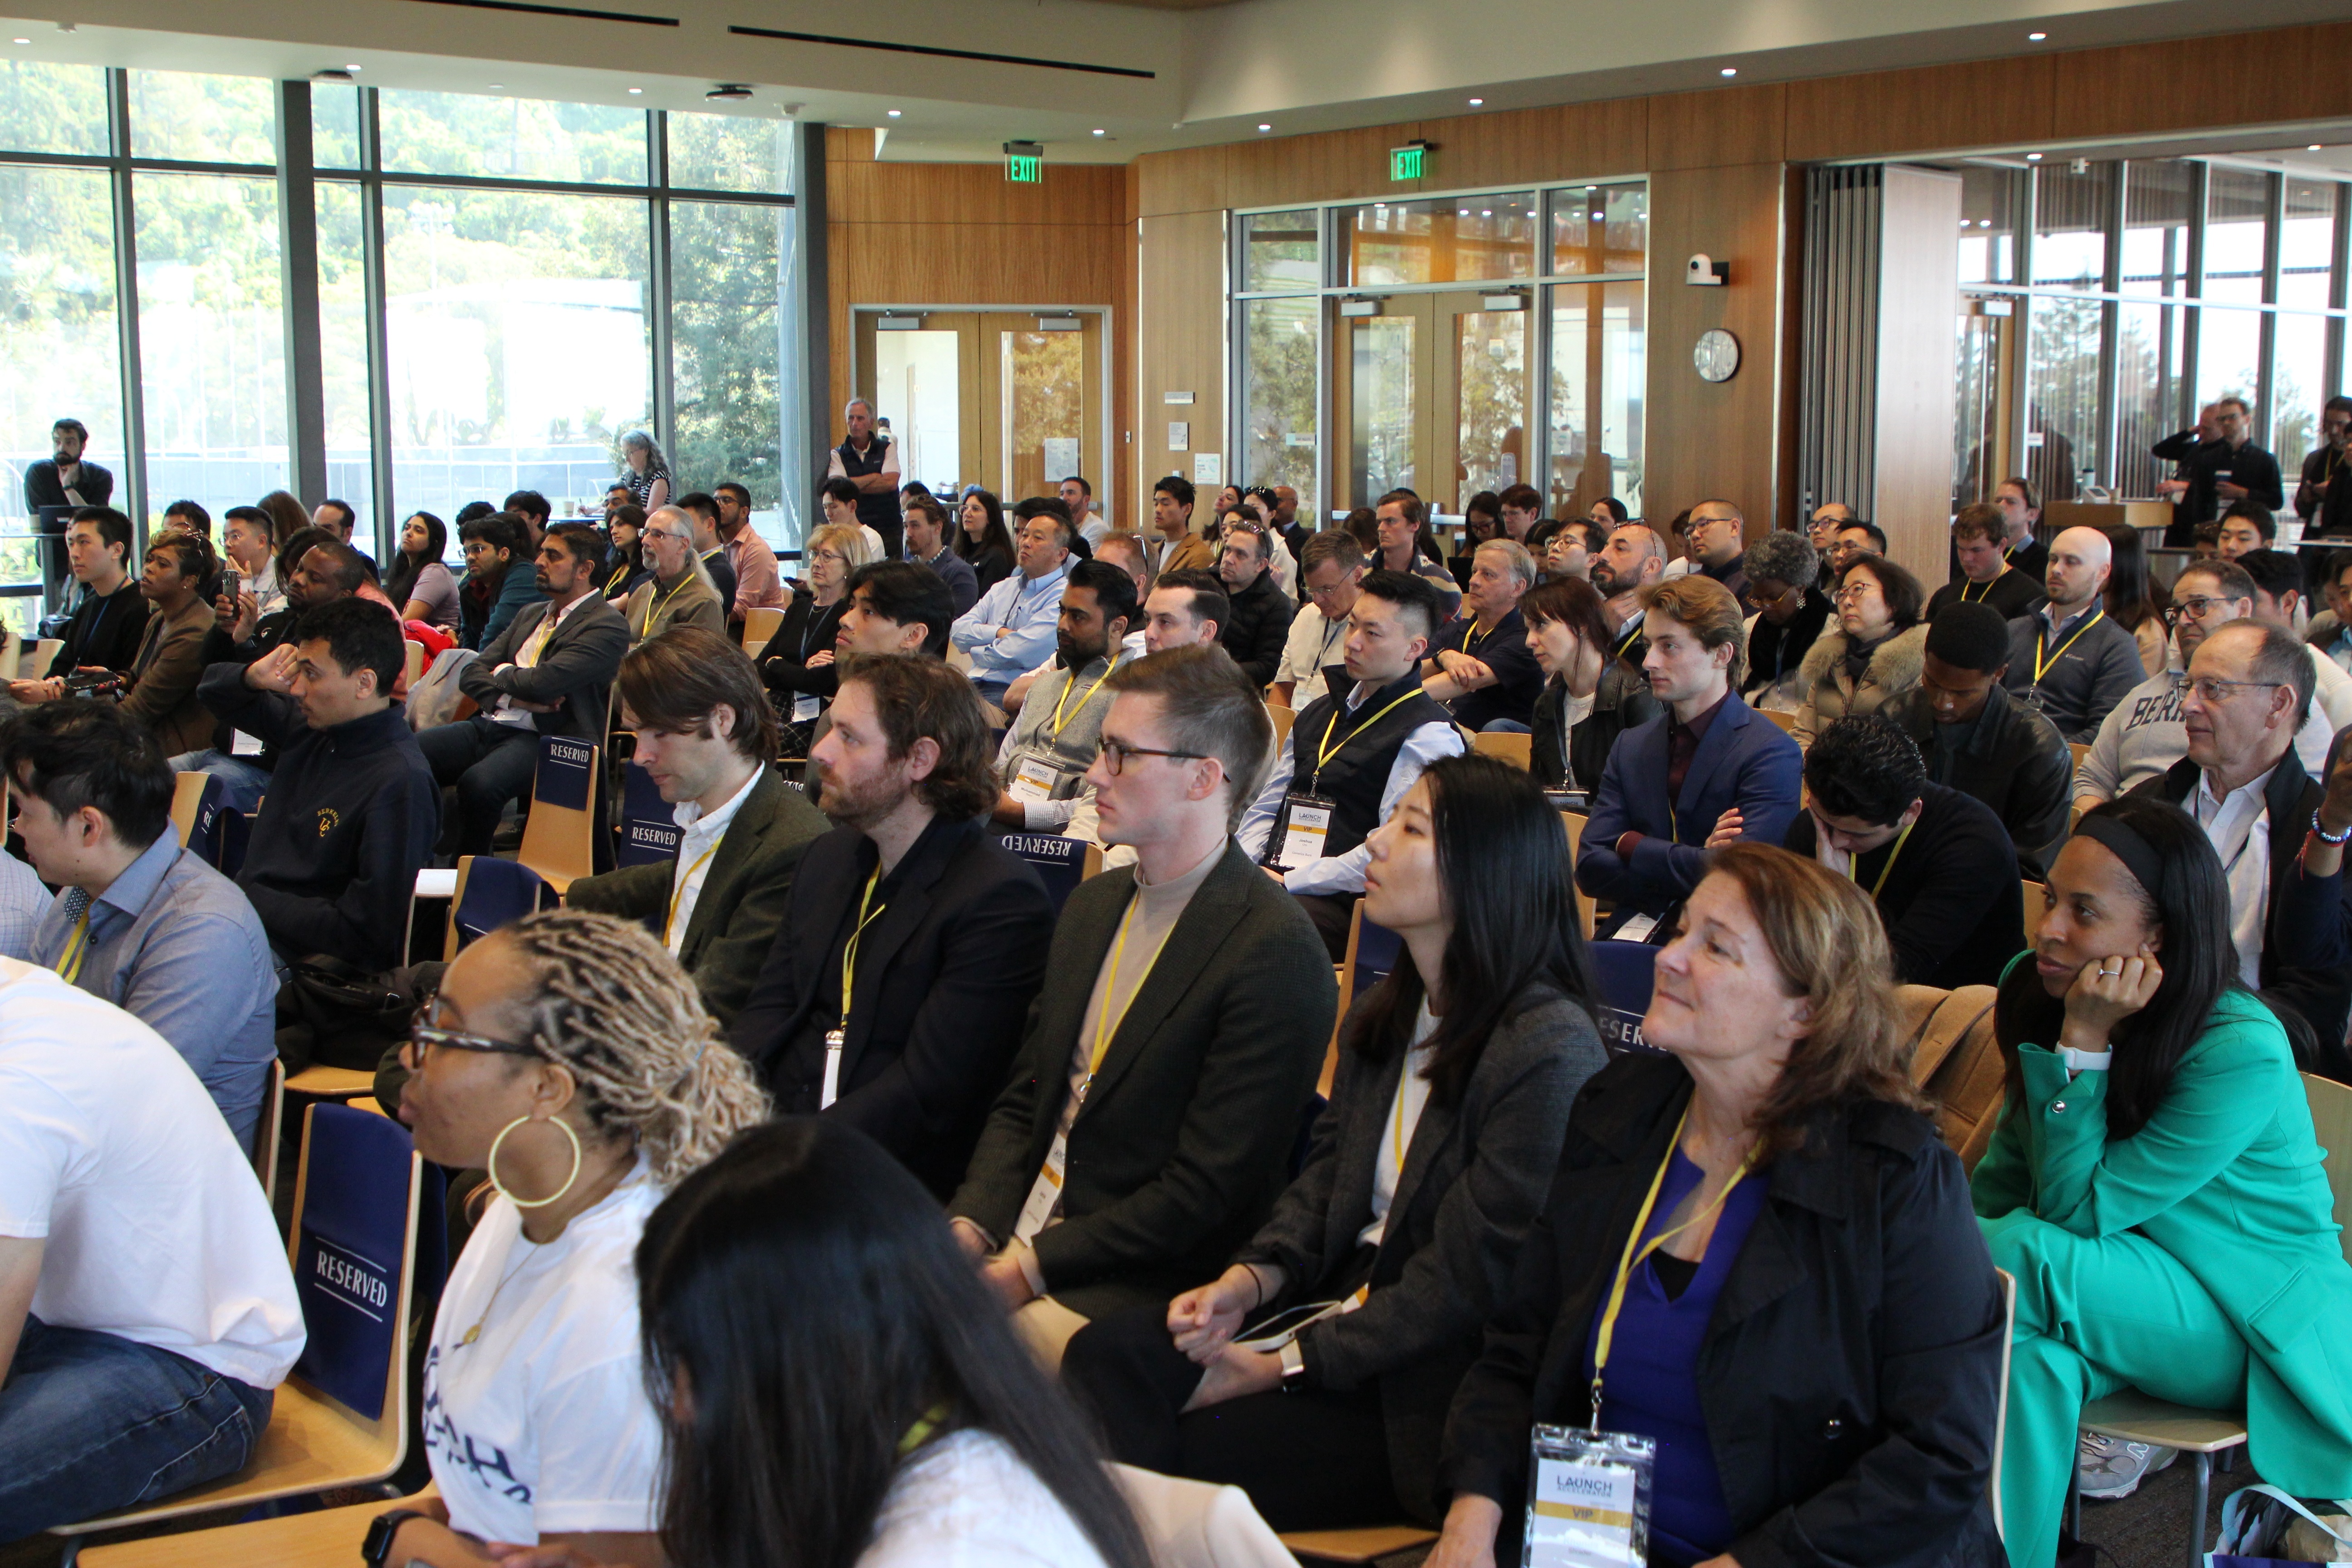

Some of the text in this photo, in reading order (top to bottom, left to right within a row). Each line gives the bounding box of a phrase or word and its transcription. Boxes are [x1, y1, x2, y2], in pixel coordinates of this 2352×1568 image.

[1011, 155, 1037, 182] EXIT
[1397, 150, 1422, 180] EXIT
[550, 744, 589, 763] RESERVED
[1028, 766, 1049, 776] LAUNCH
[632, 827, 676, 845] RESERVED
[1001, 835, 1072, 856] RESERVED
[317, 1250, 387, 1308] RESERVED
[1557, 1475, 1612, 1490] LAUNCH
[1557, 1485, 1612, 1497] ACCELERATOR
[1572, 1507, 1593, 1519] VIP
